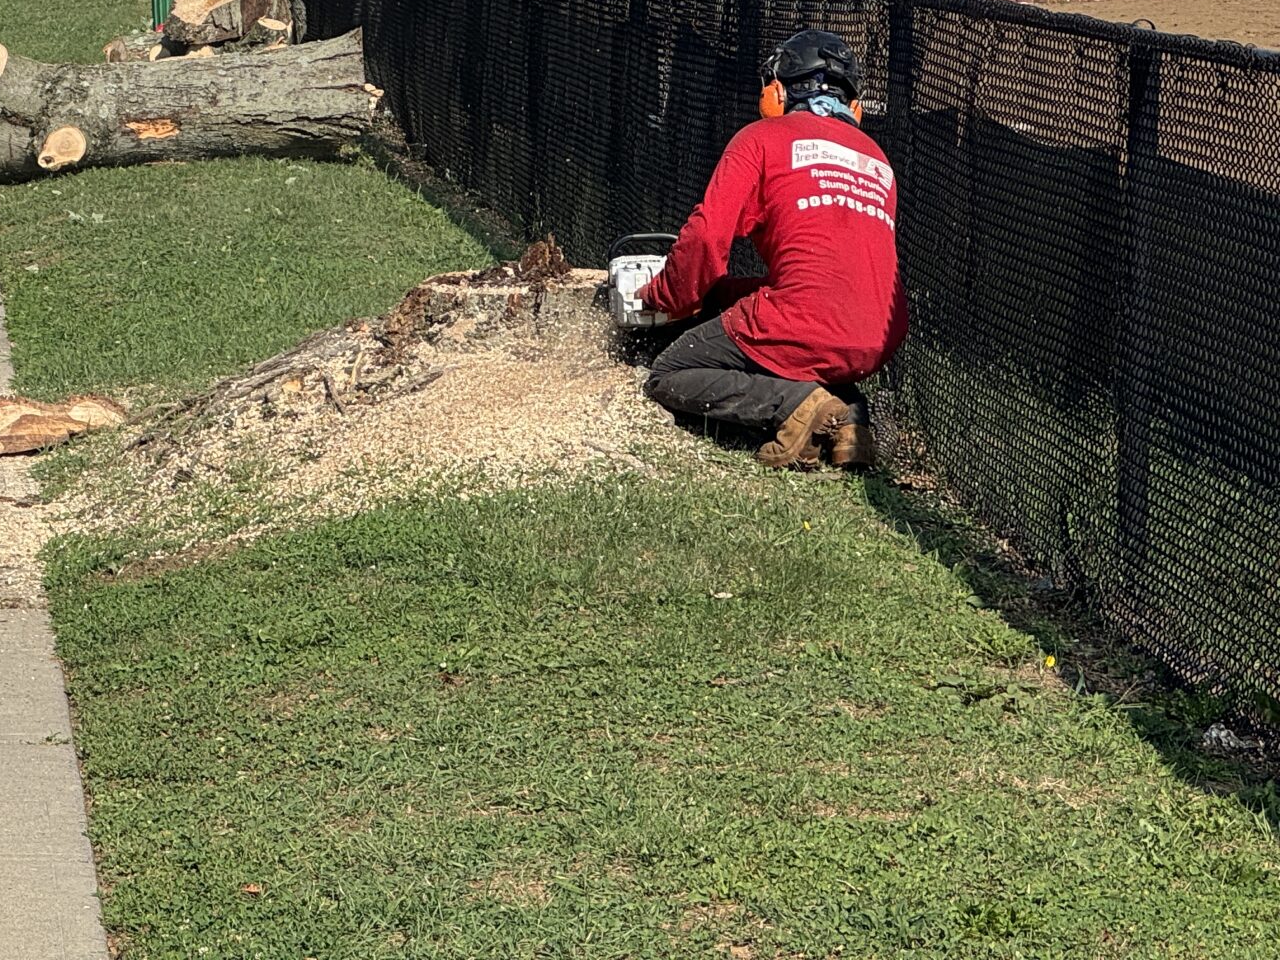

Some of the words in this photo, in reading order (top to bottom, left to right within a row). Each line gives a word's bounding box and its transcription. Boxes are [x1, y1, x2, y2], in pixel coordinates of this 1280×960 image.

[795, 141, 819, 152] Rich
[794, 152, 819, 163] Tree
[821, 151, 857, 166] Service
[818, 179, 850, 192] Stump
[851, 184, 885, 207] Grinding
